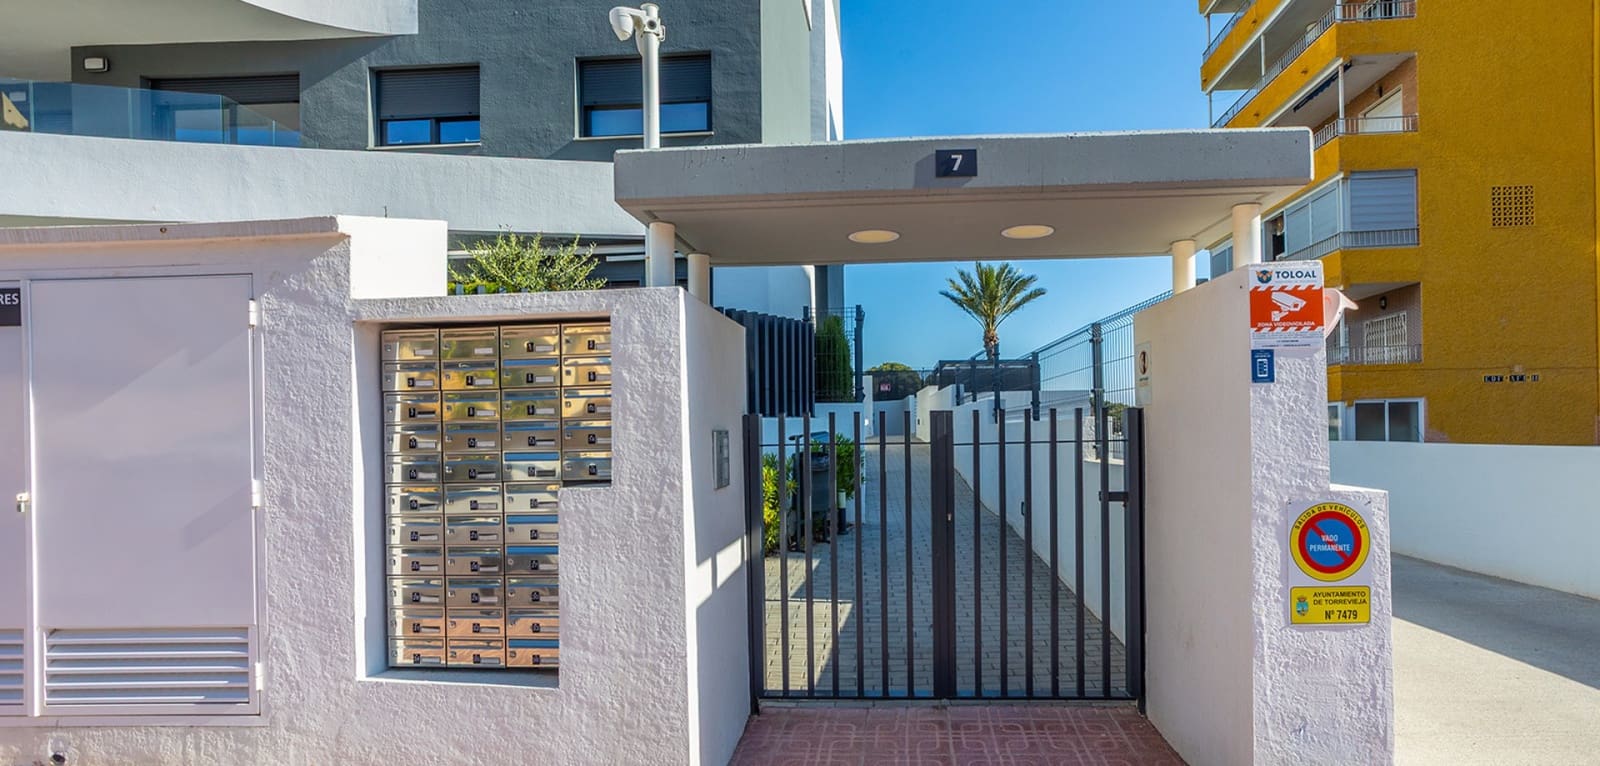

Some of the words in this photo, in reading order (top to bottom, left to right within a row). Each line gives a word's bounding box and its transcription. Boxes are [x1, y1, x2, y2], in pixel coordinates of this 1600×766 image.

[951, 154, 963, 171] 7
[1275, 270, 1317, 279] TOLOAL
[1295, 509, 1315, 530] SALIDA
[1321, 534, 1339, 542] VADO
[1309, 543, 1351, 552] PERMANENTE
[1337, 609, 1358, 620] 7479
